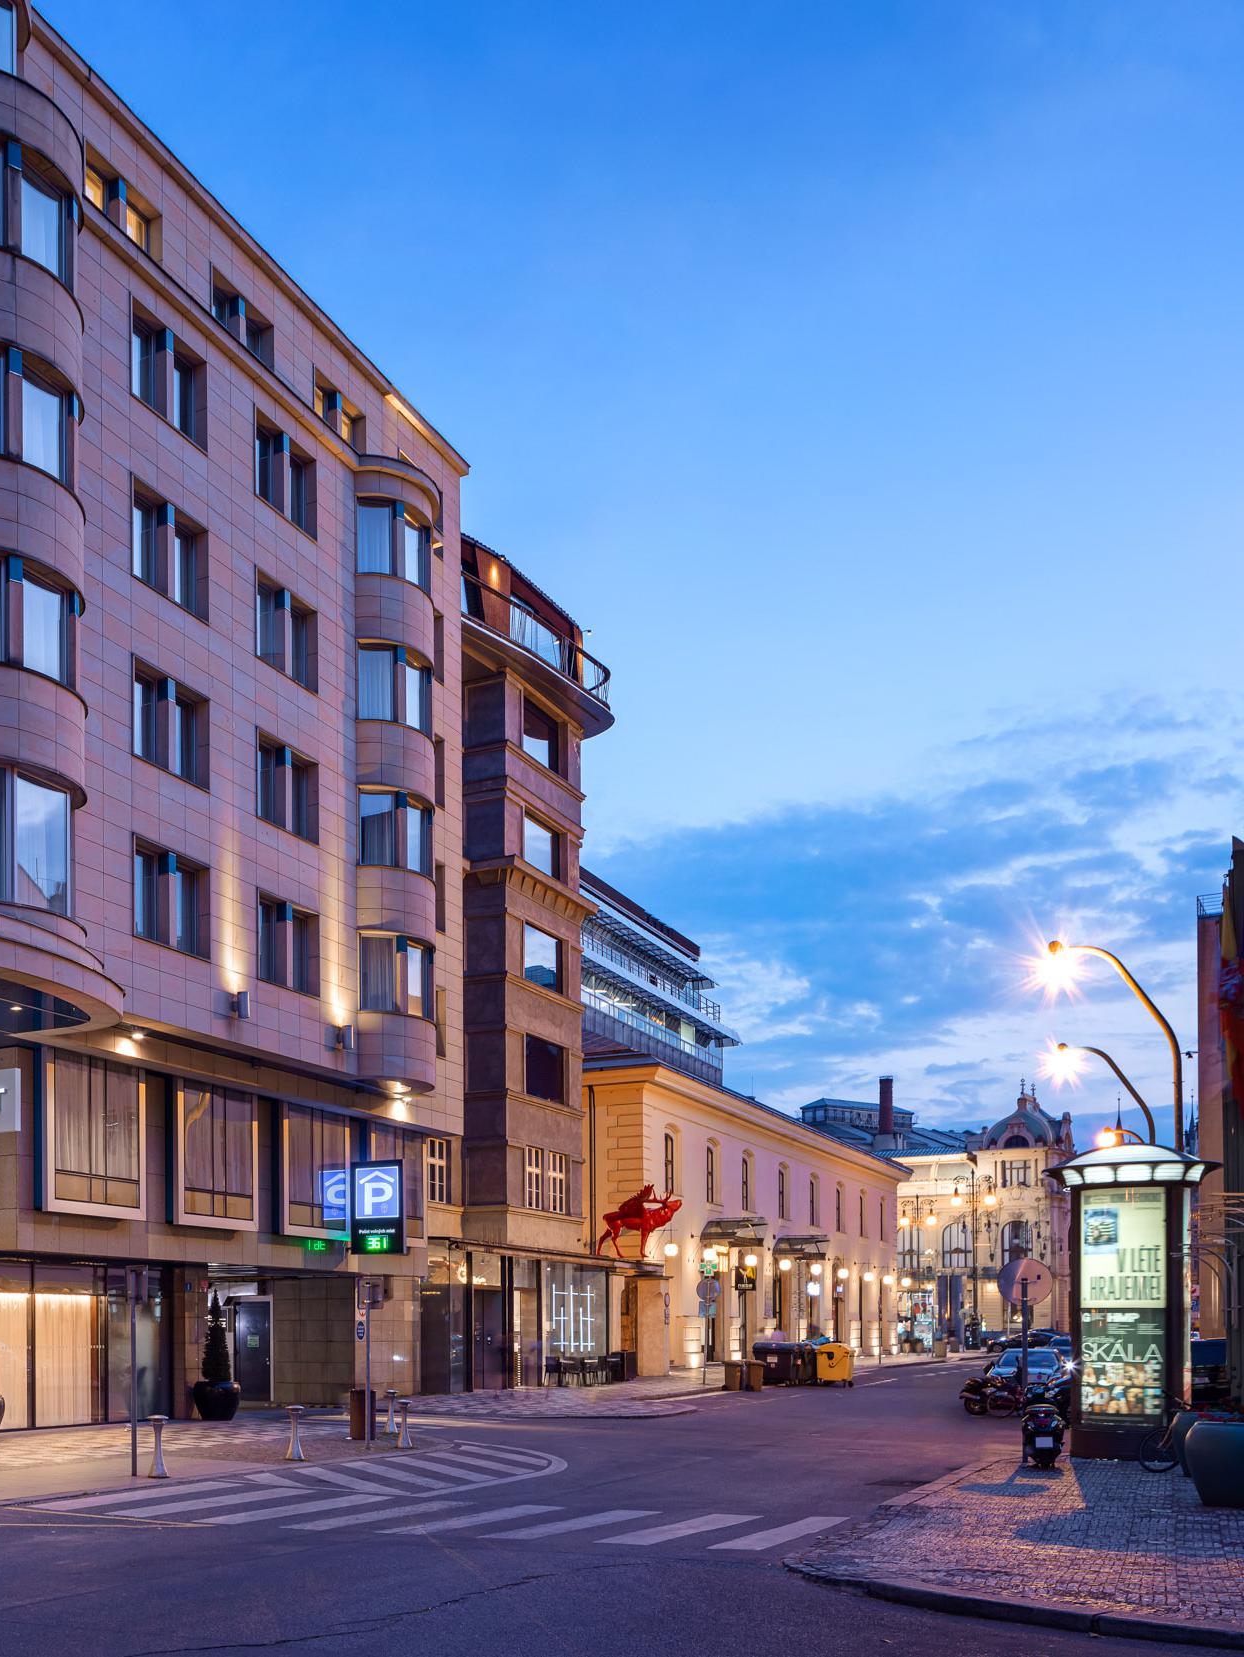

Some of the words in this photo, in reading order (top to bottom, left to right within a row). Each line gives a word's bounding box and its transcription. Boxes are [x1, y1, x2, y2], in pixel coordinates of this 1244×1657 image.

[364, 1182, 393, 1216] P
[367, 1237, 386, 1249] 361
[1118, 1248, 1127, 1273] V
[1082, 1339, 1164, 1362] SKÁLA
